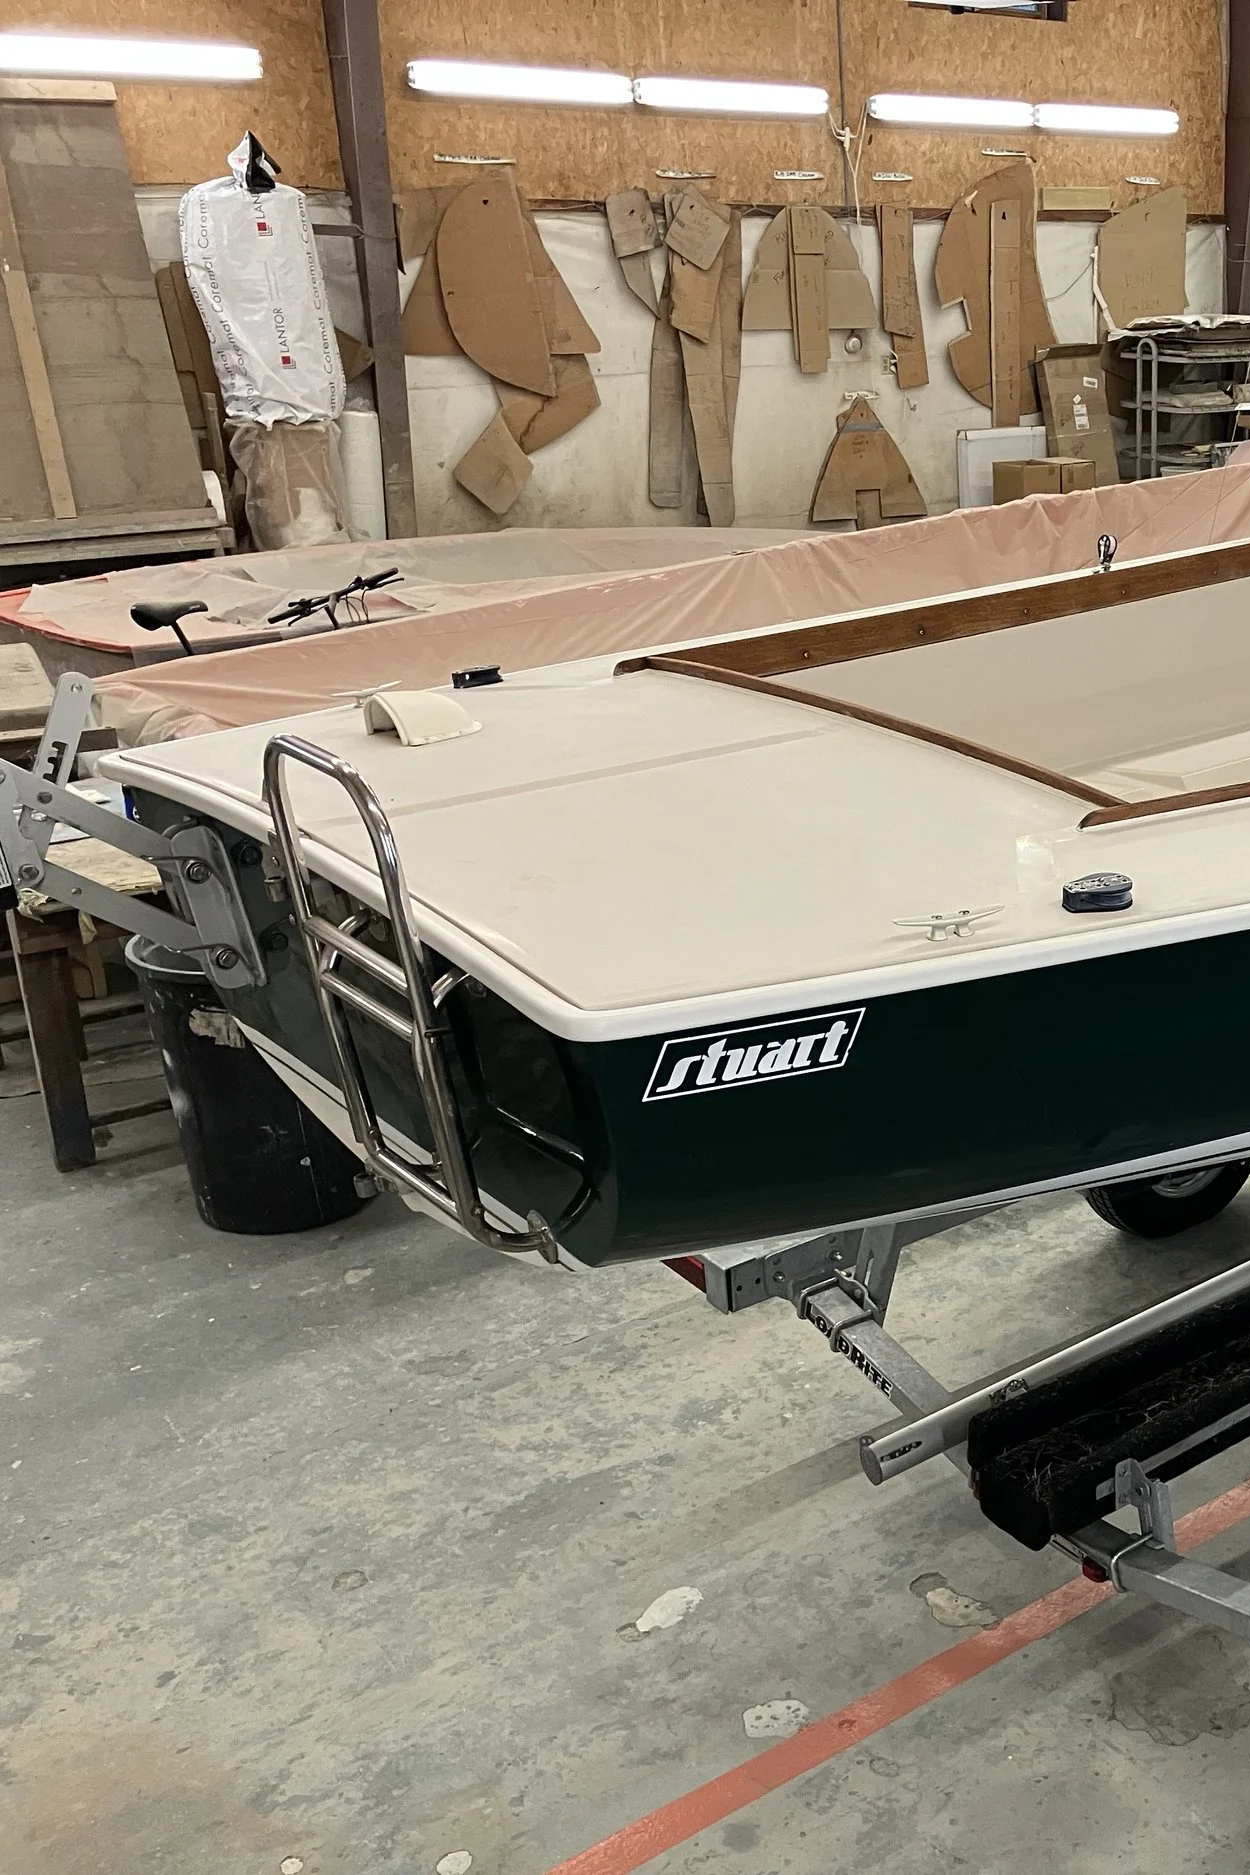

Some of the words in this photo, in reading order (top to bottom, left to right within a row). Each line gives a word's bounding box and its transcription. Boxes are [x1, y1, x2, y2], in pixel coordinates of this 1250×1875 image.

[252, 195, 266, 219] LAN
[298, 195, 309, 244] Corem
[202, 256, 223, 313] Coremat
[306, 251, 321, 310] Coremat
[220, 319, 248, 377] Coremat
[272, 306, 290, 353] LANTOR
[318, 317, 333, 374] Coremat
